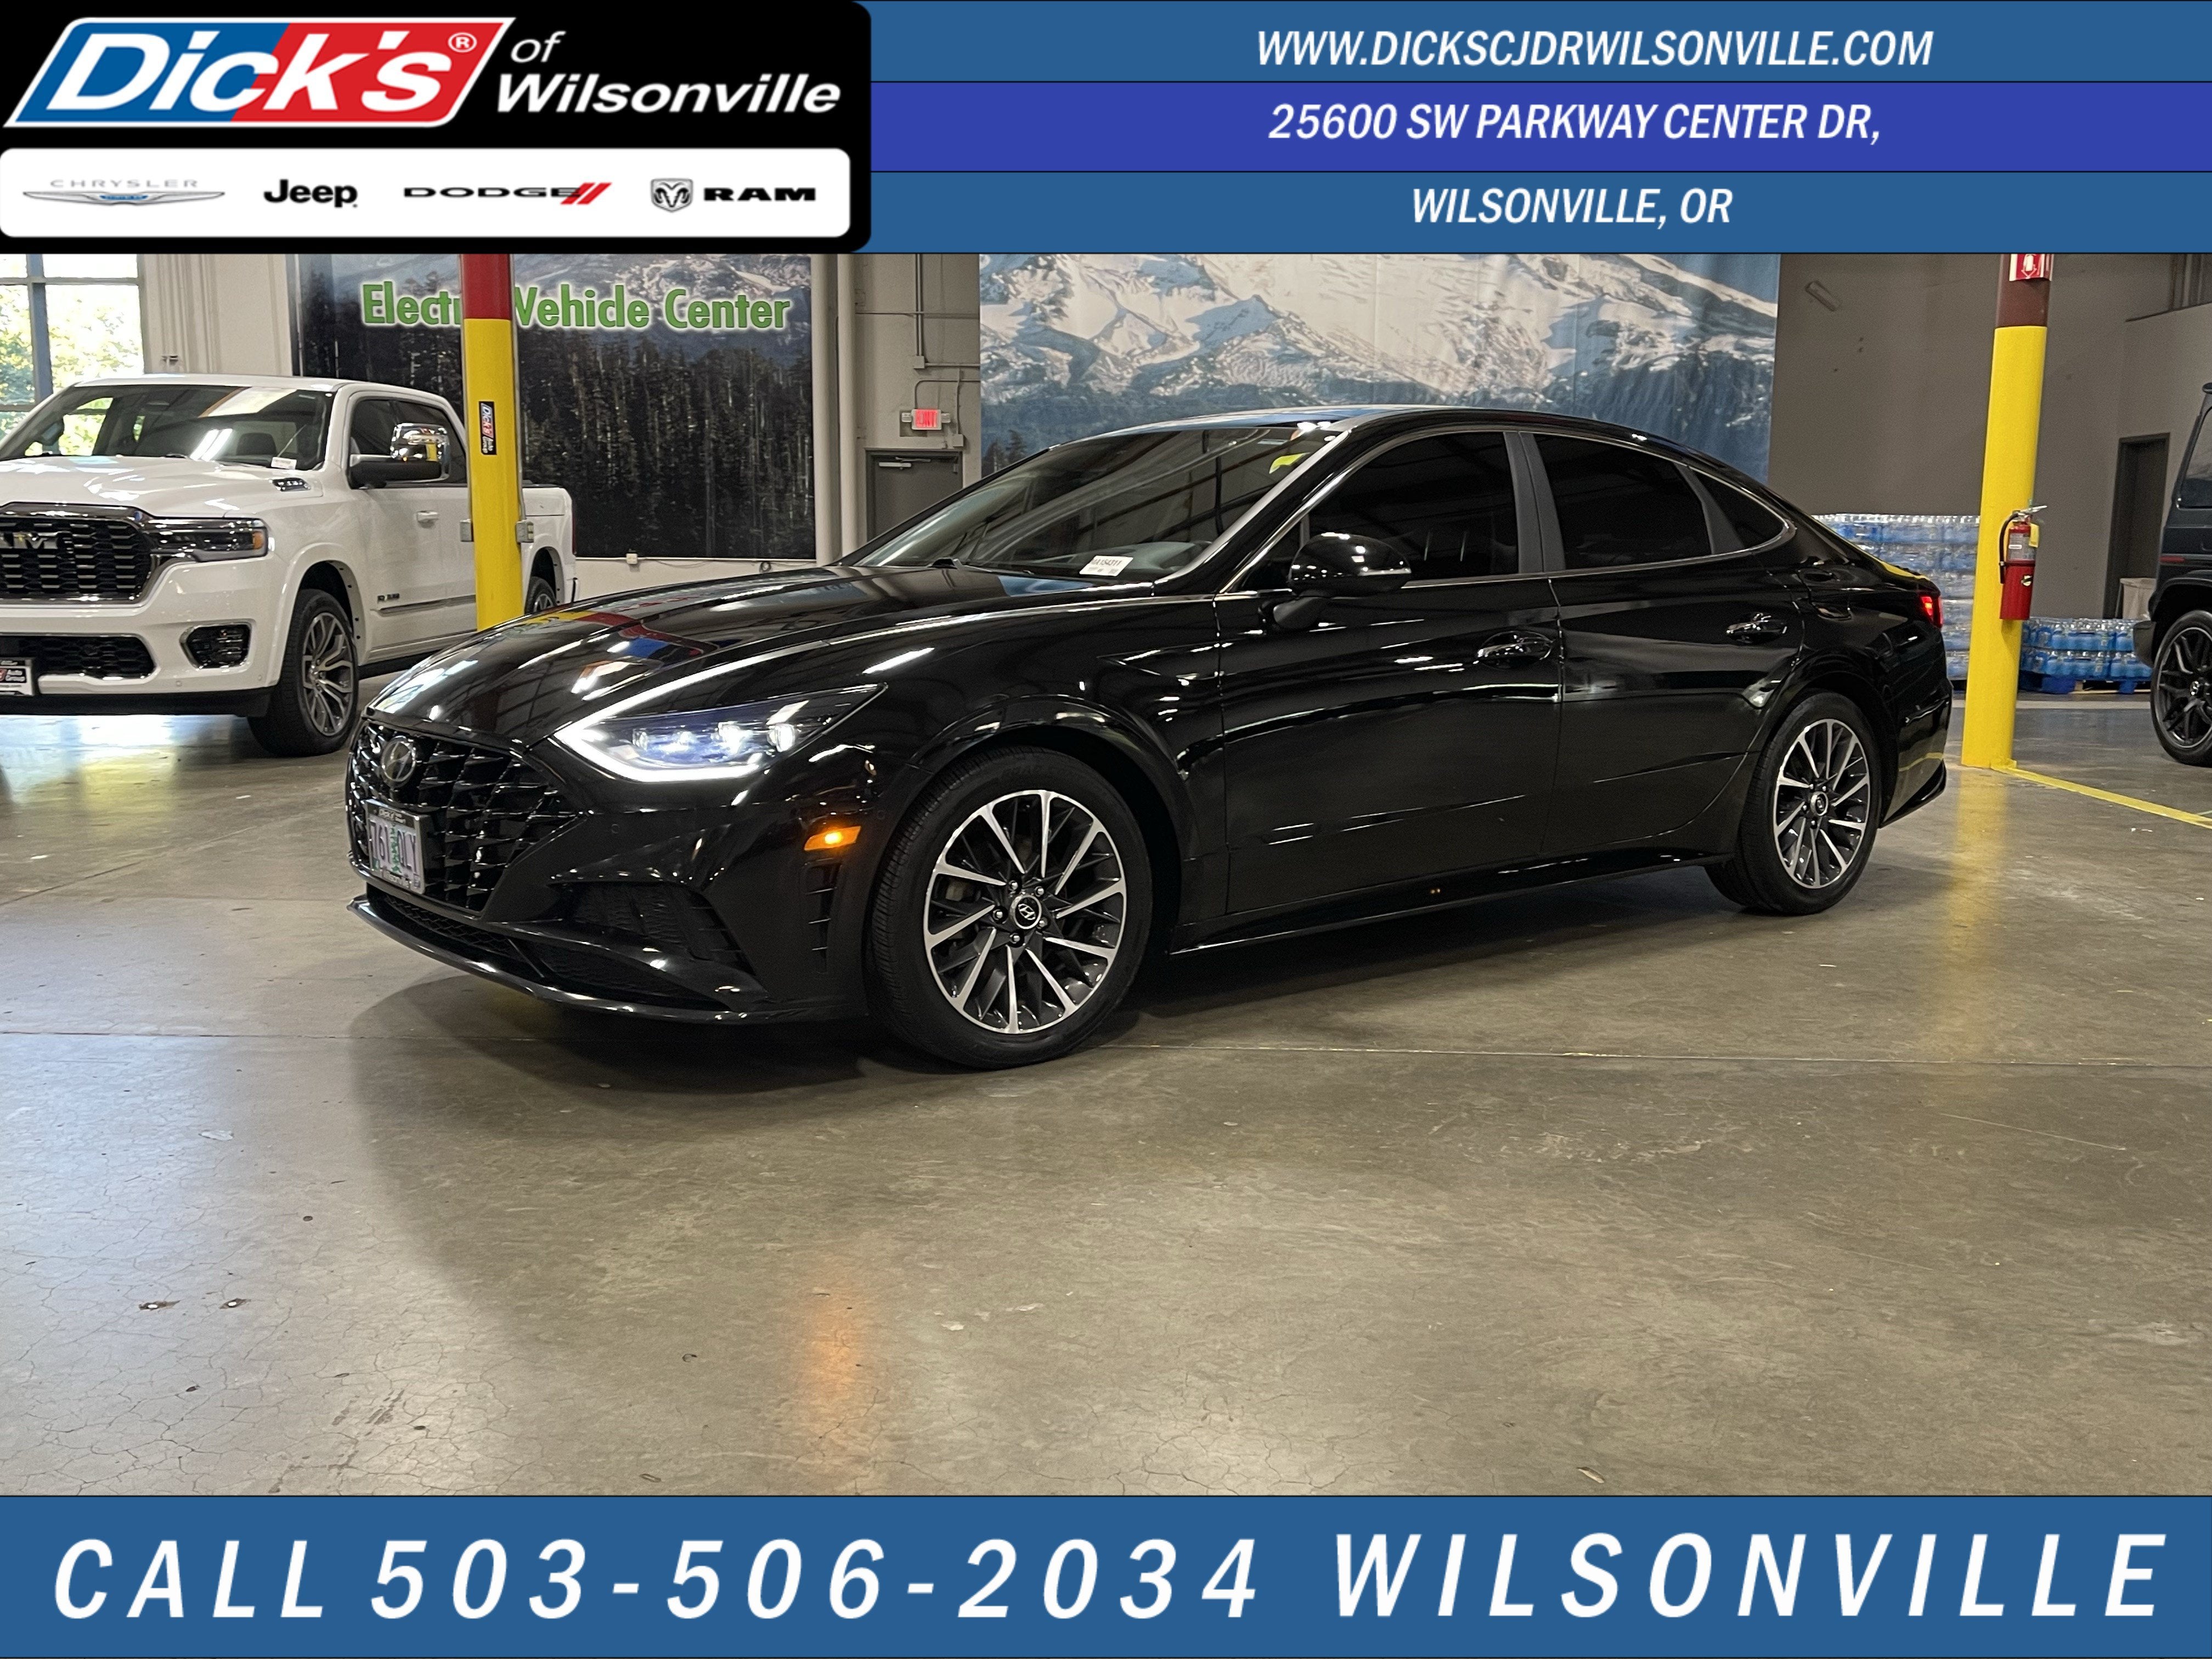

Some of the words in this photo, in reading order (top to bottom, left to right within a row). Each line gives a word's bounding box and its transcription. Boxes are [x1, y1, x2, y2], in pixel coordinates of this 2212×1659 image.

[515, 284, 650, 328] Vehicle
[665, 288, 791, 329] Center
[369, 820, 391, 864] 761
